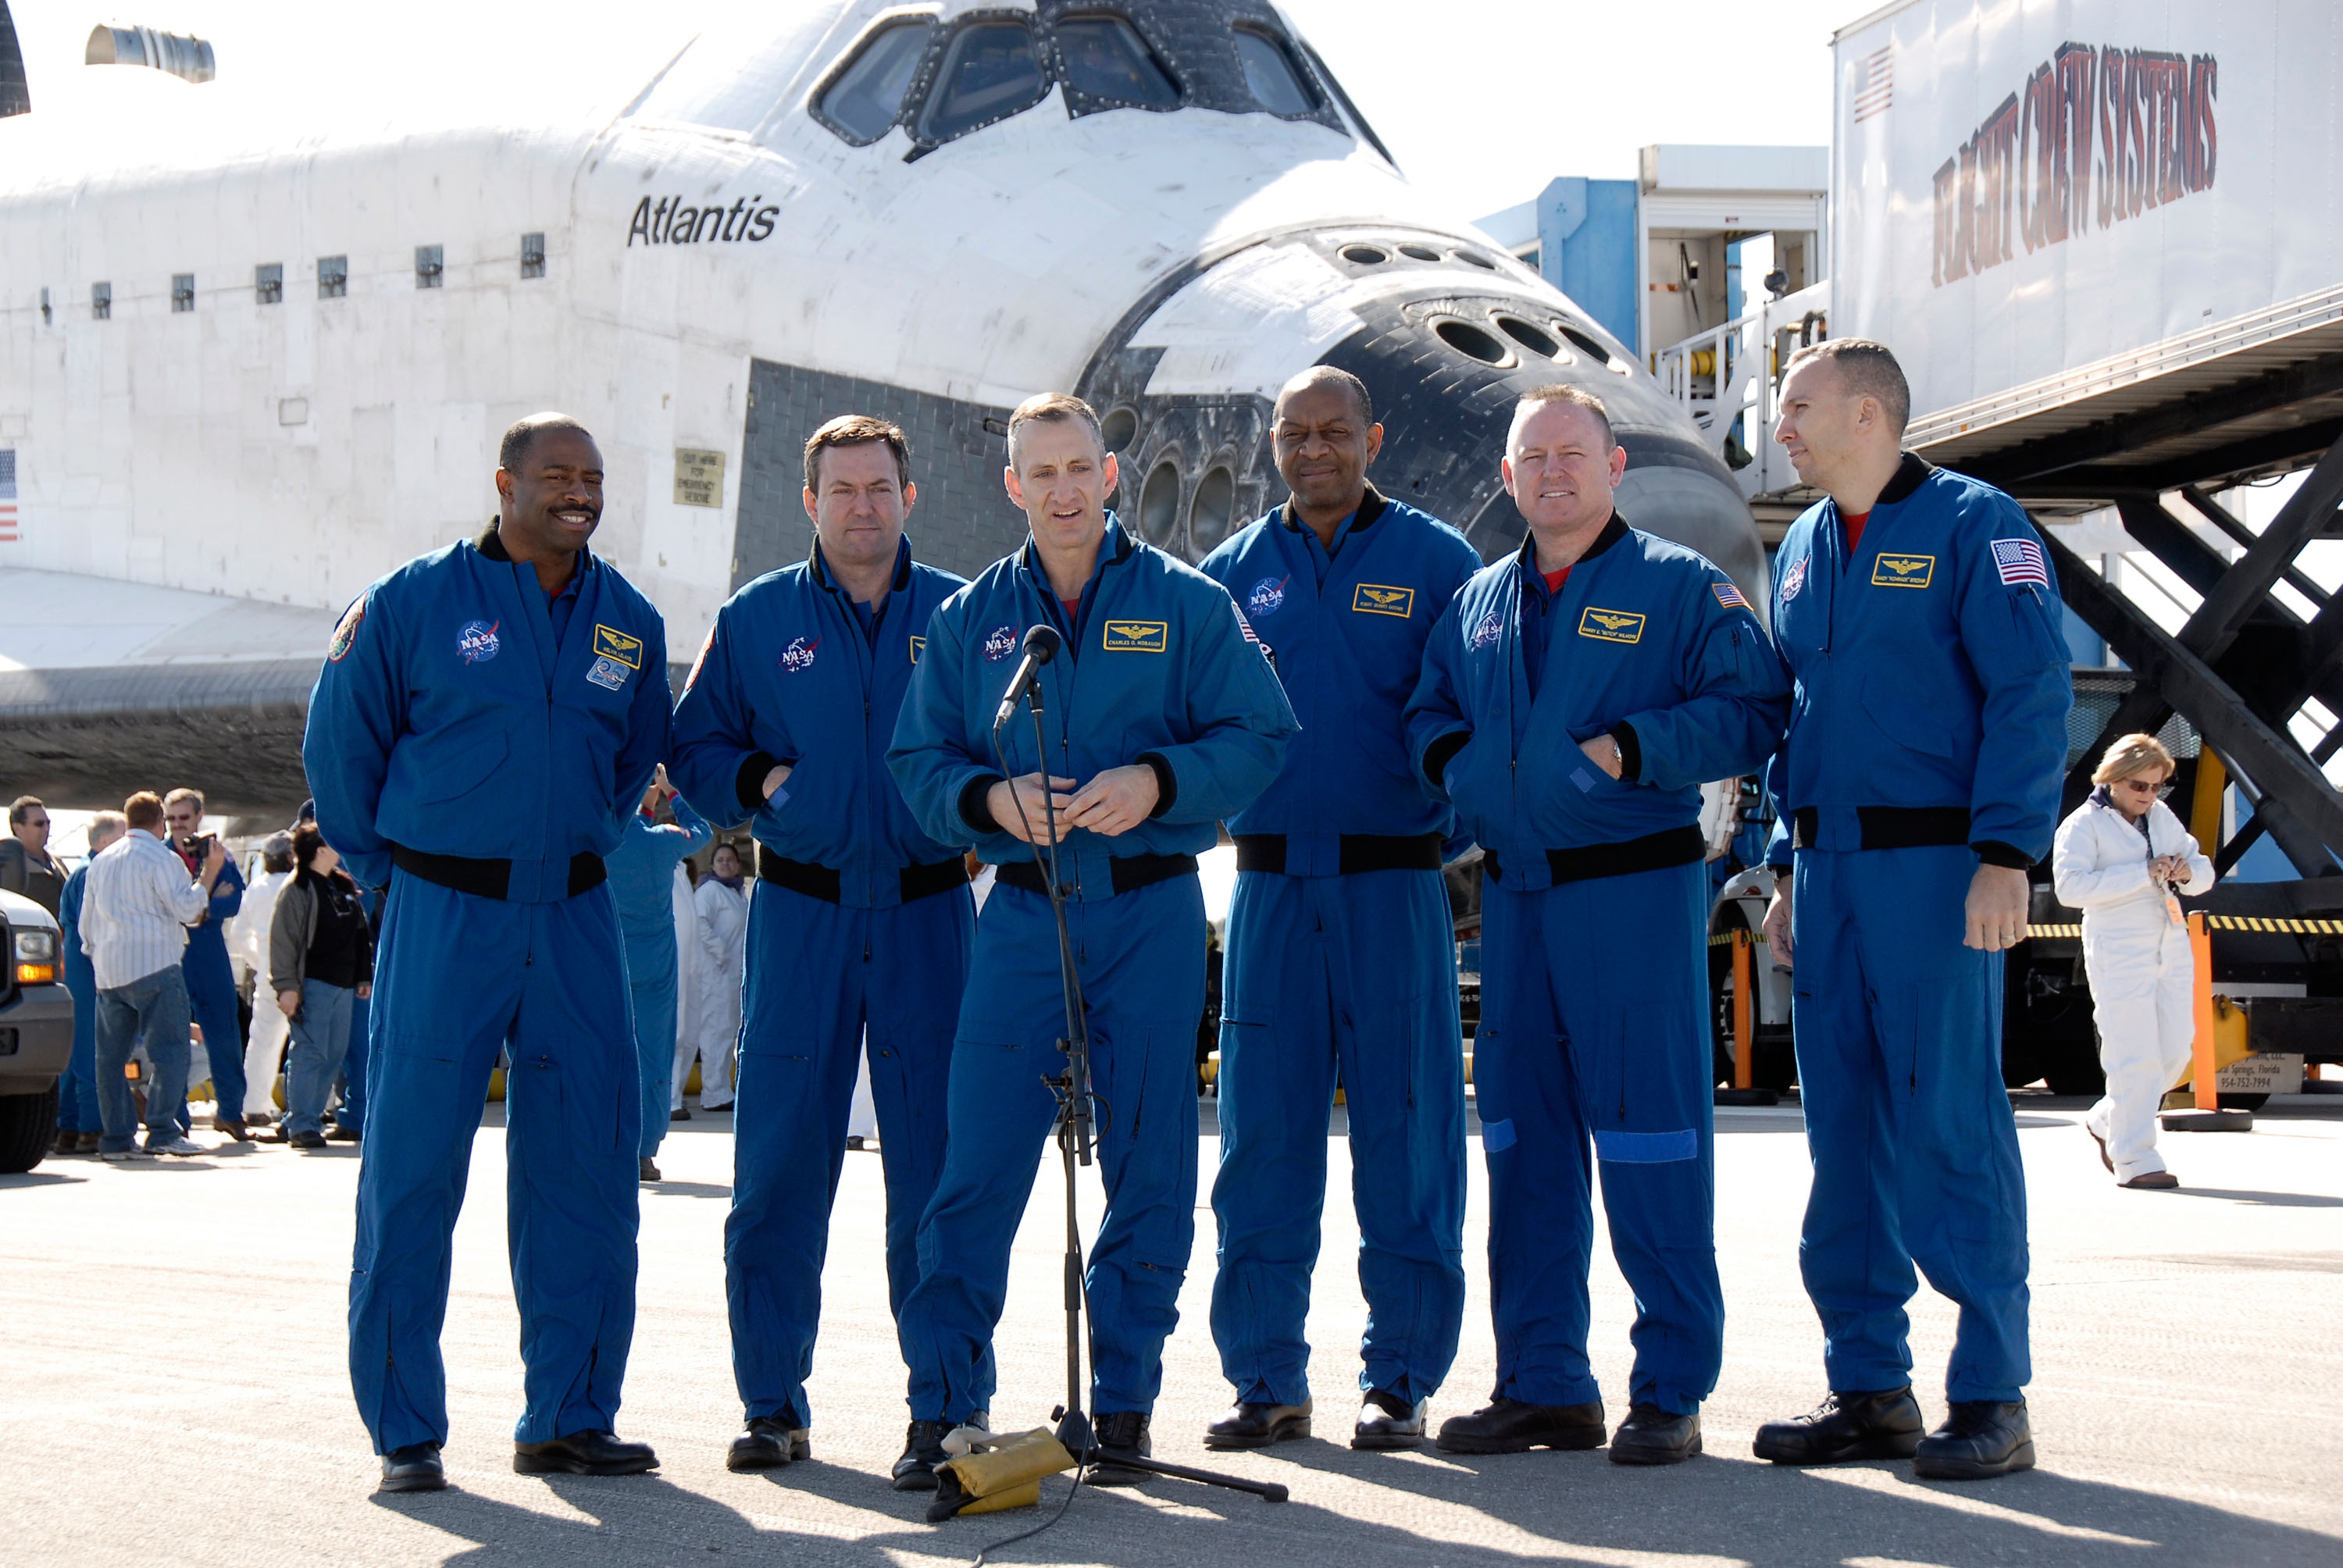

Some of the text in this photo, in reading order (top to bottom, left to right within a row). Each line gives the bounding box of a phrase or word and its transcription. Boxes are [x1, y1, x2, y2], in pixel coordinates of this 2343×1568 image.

[1931, 40, 2218, 288] FLIGHT CREW SYSTEMS
[627, 194, 780, 247] Atlantis
[691, 466, 704, 477] FOR
[1250, 590, 1283, 605] NASA
[461, 633, 499, 650] NASA
[986, 637, 1016, 651] NASA
[783, 650, 815, 663] NASA
[594, 661, 625, 685] 25
[2231, 1064, 2256, 1076] Springs,
[2259, 1064, 2280, 1074] Florida
[2221, 1078, 2270, 1088] 954-752-7994
